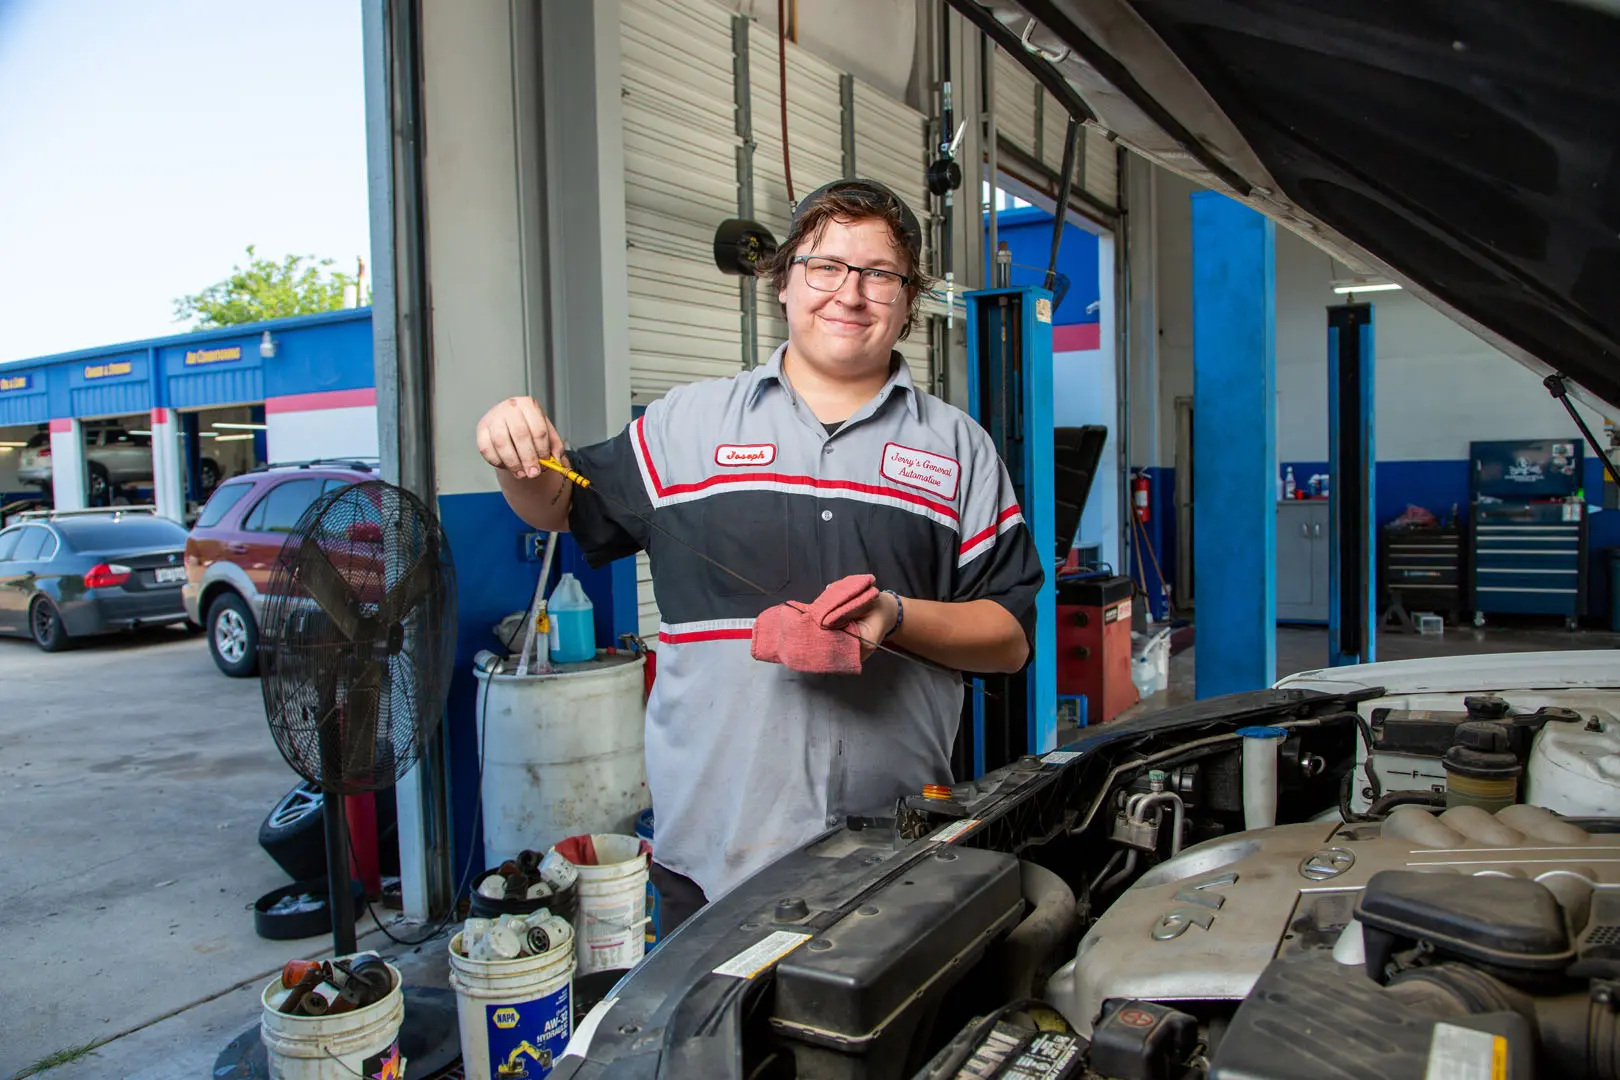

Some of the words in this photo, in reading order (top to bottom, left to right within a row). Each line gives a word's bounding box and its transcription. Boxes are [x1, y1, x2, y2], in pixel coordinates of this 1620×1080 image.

[726, 450, 765, 461] Joseph
[891, 452, 921, 468] Jerry's
[923, 459, 953, 478] General
[898, 467, 942, 487] Automotive
[1151, 872, 1240, 942] V6
[496, 1013, 516, 1024] NAPA
[544, 1010, 568, 1032] AW-32
